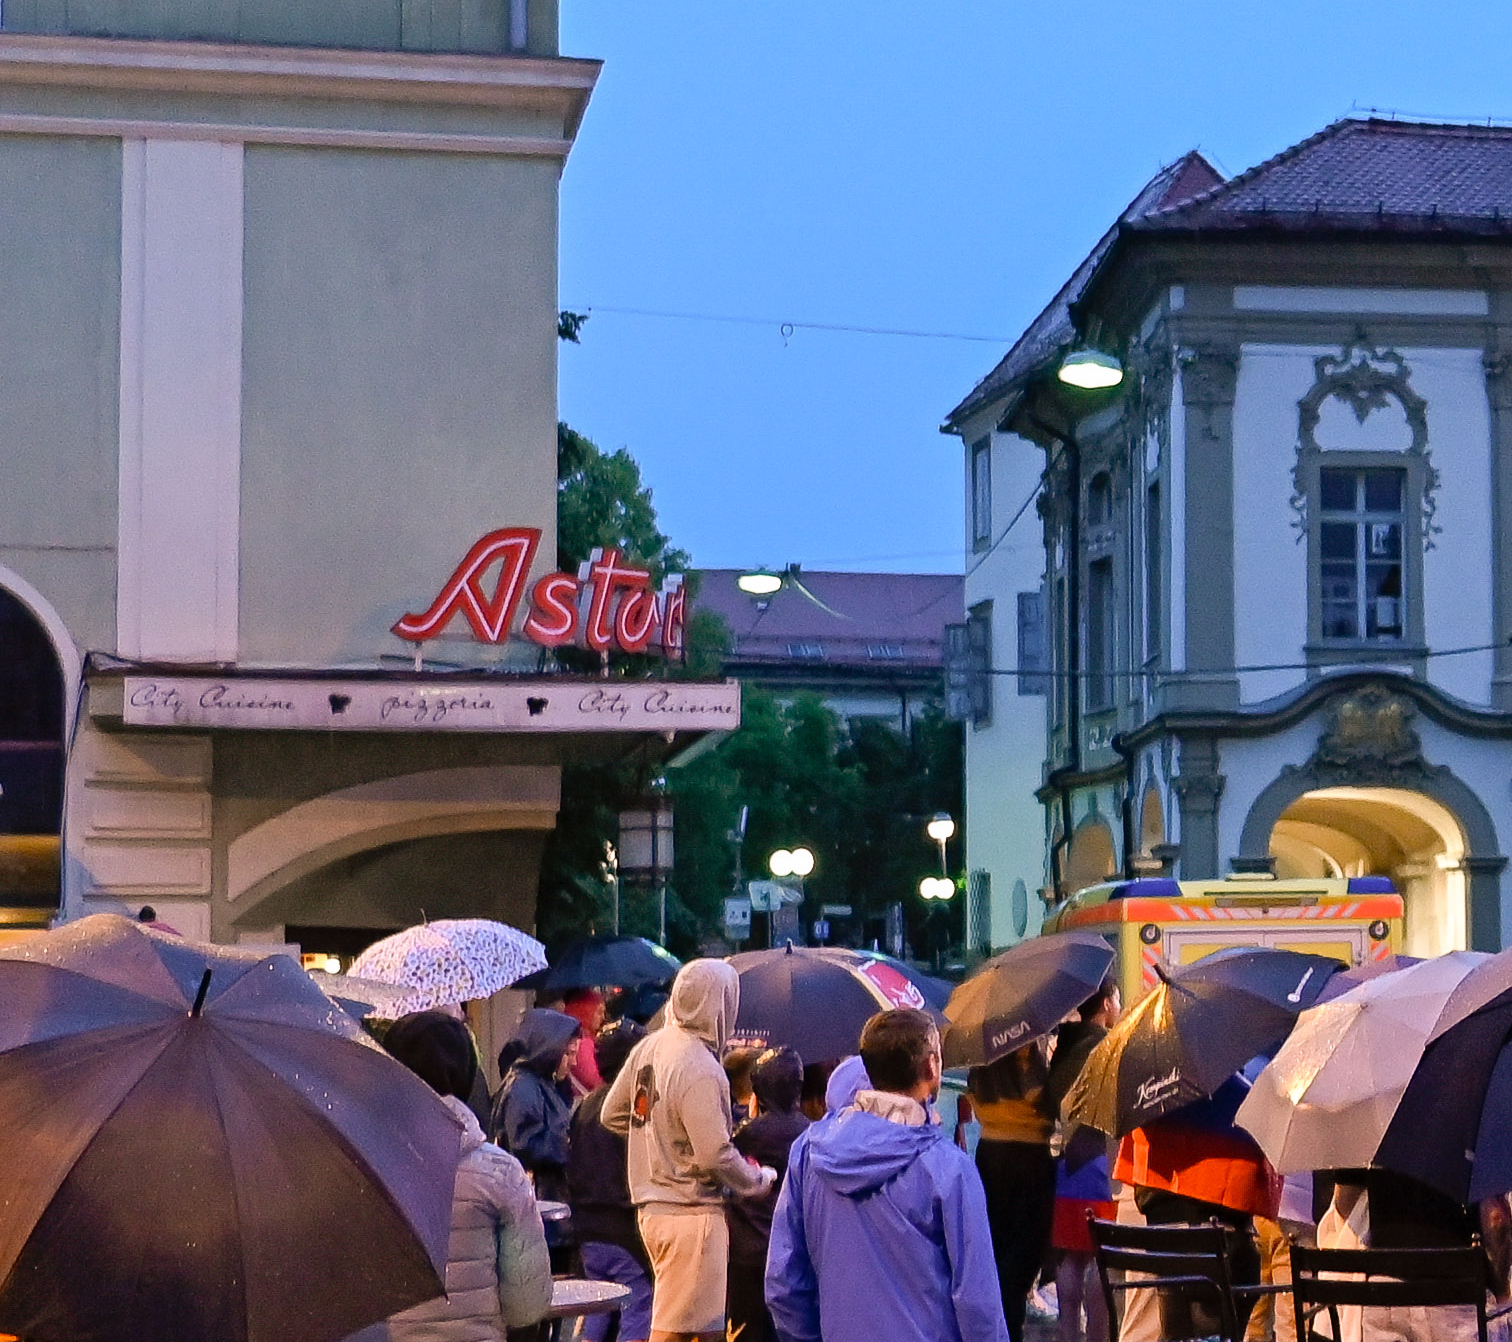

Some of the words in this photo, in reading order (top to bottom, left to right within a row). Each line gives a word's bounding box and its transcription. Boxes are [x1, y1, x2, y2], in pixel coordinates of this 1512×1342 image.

[130, 684, 184, 714] City
[199, 684, 295, 710] Cuisine
[381, 691, 495, 722] pizzeria
[578, 689, 632, 722] City
[643, 690, 735, 715] Cuisine
[992, 1020, 1031, 1048] NASA
